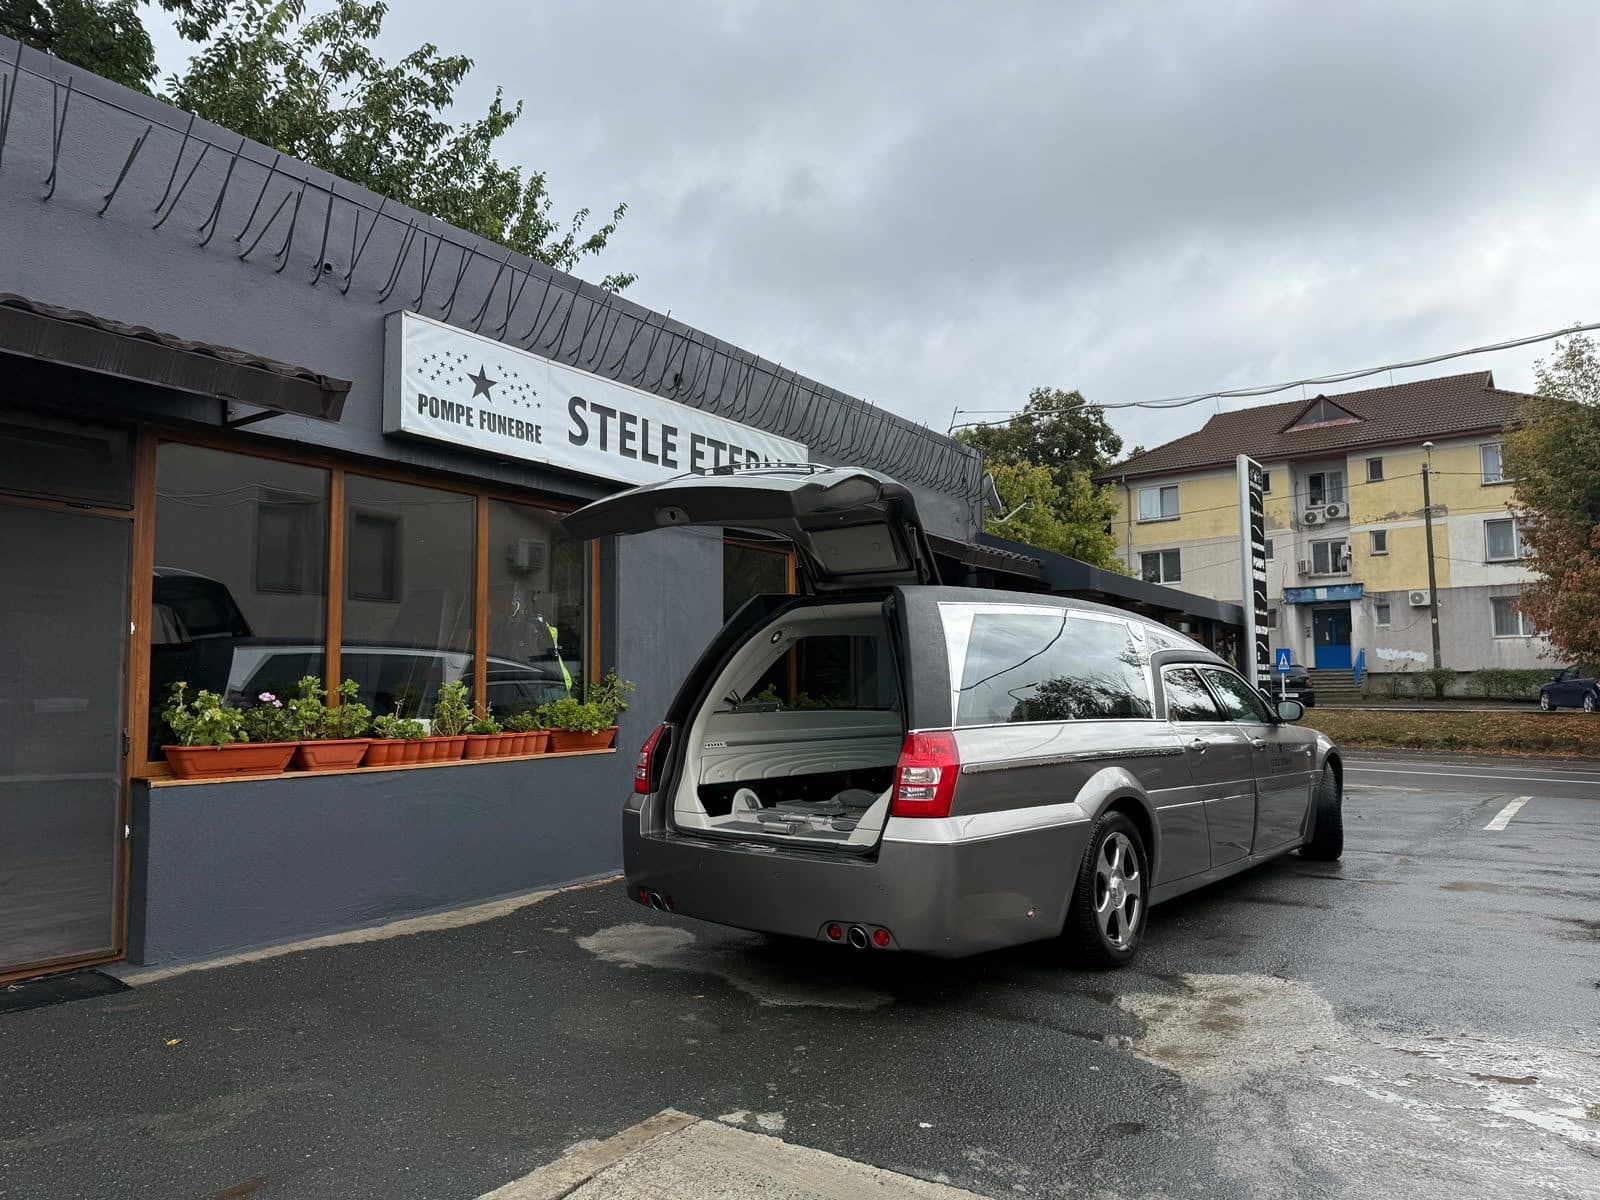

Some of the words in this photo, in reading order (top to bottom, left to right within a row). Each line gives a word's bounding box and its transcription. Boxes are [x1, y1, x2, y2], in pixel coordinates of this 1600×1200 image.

[418, 393, 474, 427] POMPE
[479, 409, 542, 444] FUNEBRE
[568, 396, 678, 470] STELE
